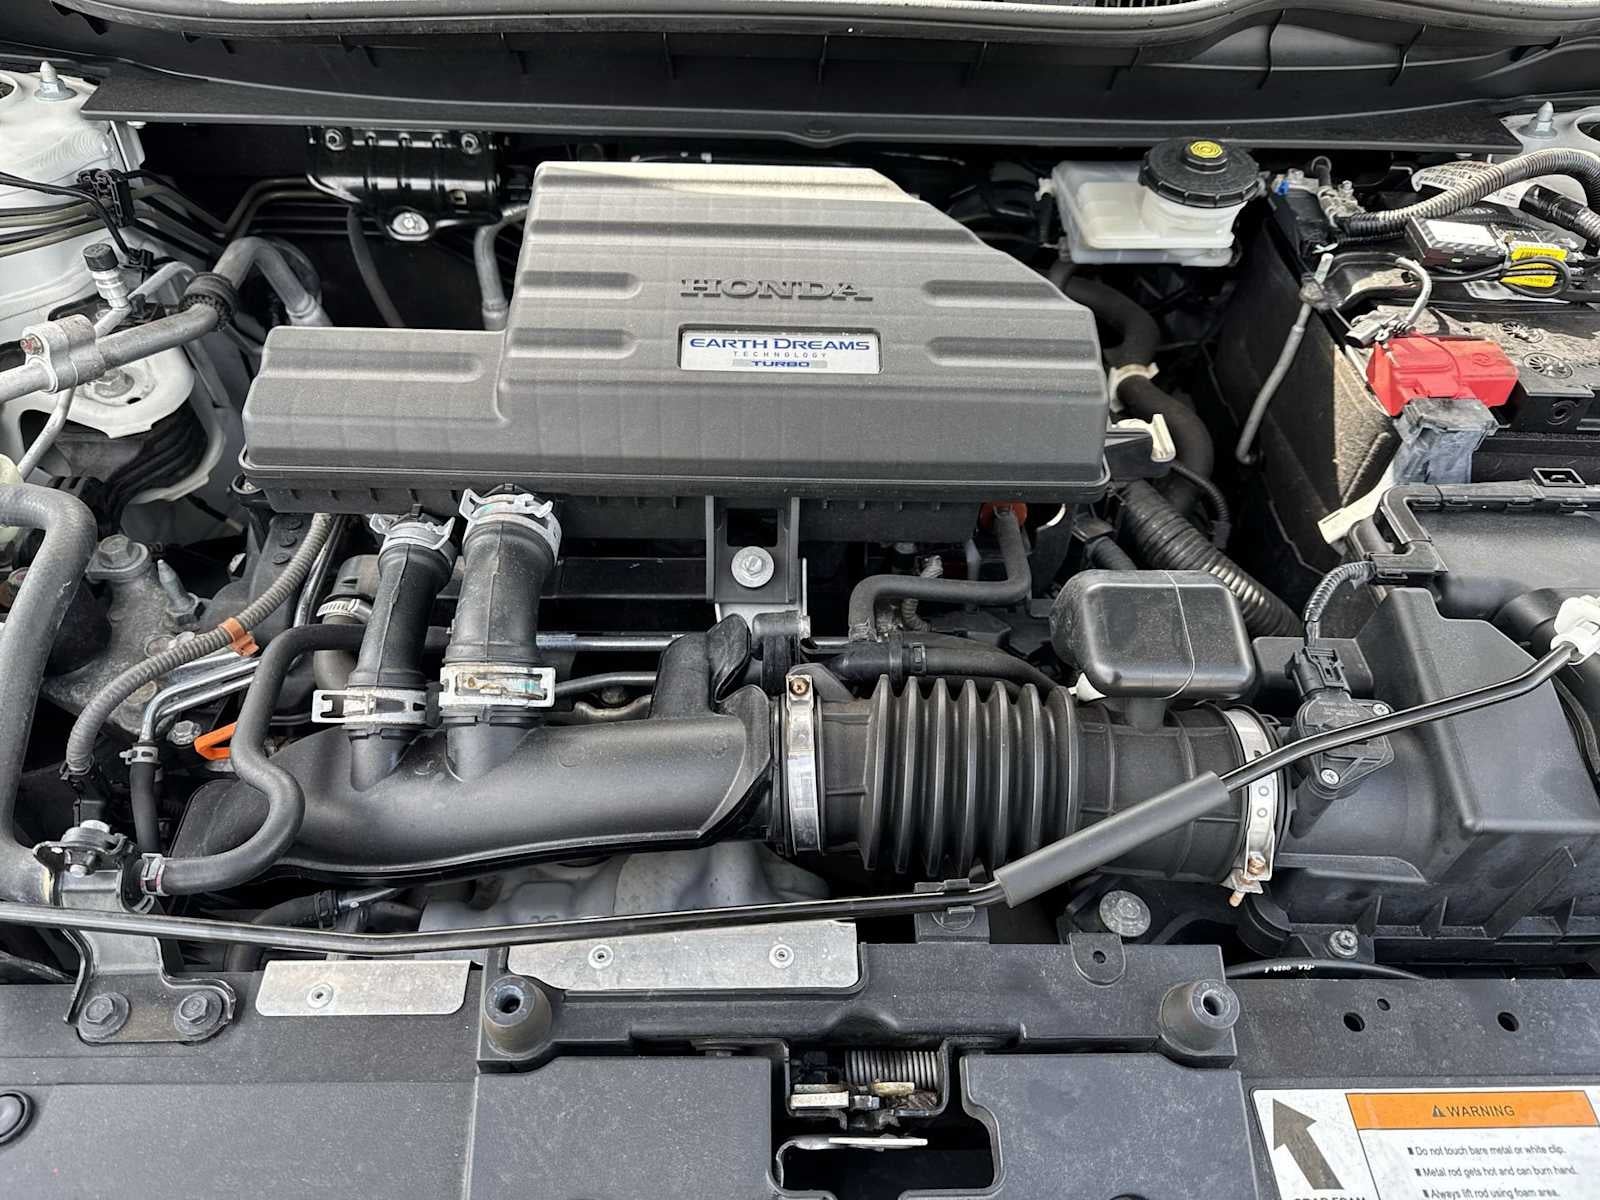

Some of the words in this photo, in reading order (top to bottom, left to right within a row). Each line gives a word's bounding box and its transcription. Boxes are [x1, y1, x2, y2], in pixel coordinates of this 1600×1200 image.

[680, 278, 873, 301] HONDA
[689, 338, 768, 350] EARTH
[774, 338, 870, 351] DREAMS
[734, 351, 827, 359] TECHNOLOGY
[1446, 1105, 1515, 1118] WARNING
[1415, 1147, 1428, 1156] Do
[1430, 1147, 1444, 1156] not
[1444, 1146, 1468, 1156] touch
[1468, 1146, 1488, 1155] bare
[1490, 1145, 1512, 1155] metal
[1514, 1146, 1523, 1154] or
[1525, 1145, 1547, 1154] white
[1422, 1167, 1447, 1177] Metal
[1448, 1167, 1462, 1177] rod
[1463, 1168, 1482, 1179] gets
[1482, 1166, 1498, 1176] hot
[1499, 1166, 1515, 1176] and
[1516, 1167, 1533, 1176] can
[1532, 1166, 1553, 1176] burn
[1431, 1188, 1461, 1200] Always
[1461, 1188, 1474, 1198] lift
[1474, 1188, 1489, 1198] rod
[1490, 1189, 1514, 1200] using
[1514, 1187, 1537, 1198] foam
